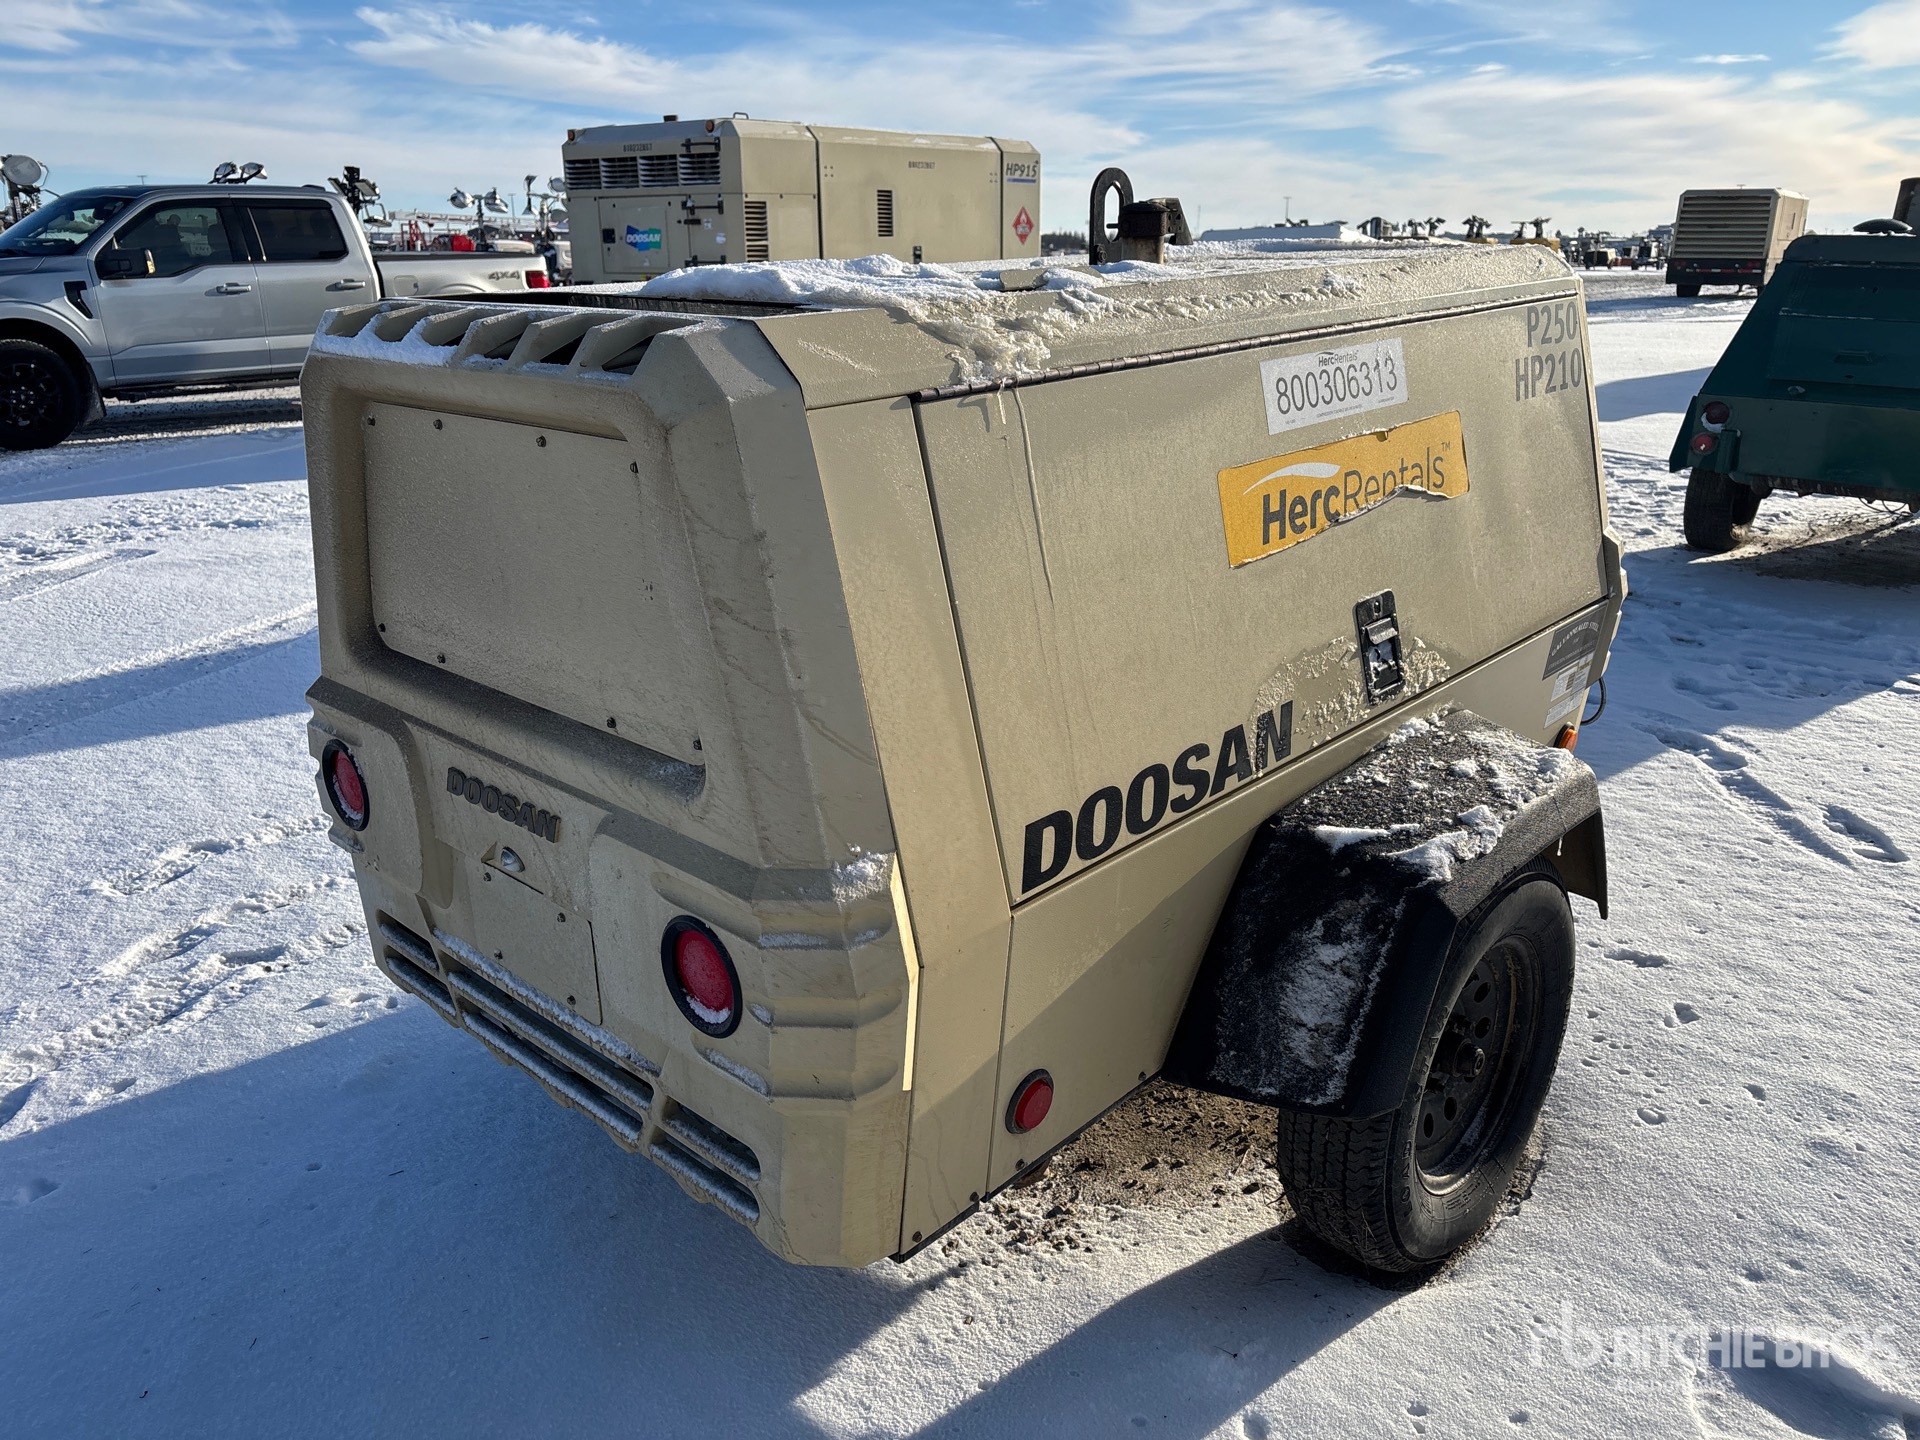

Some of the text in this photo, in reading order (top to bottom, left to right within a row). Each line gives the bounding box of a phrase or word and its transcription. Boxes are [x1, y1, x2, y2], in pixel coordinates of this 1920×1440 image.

[1005, 163, 1037, 178] HP915
[626, 233, 661, 243] DOOSAN
[1527, 301, 1578, 348] P250
[1275, 356, 1398, 415] 800306313
[1515, 348, 1582, 402] HP210
[446, 766, 562, 844] DOOSAN
[1021, 700, 1293, 895] DOOSAN
